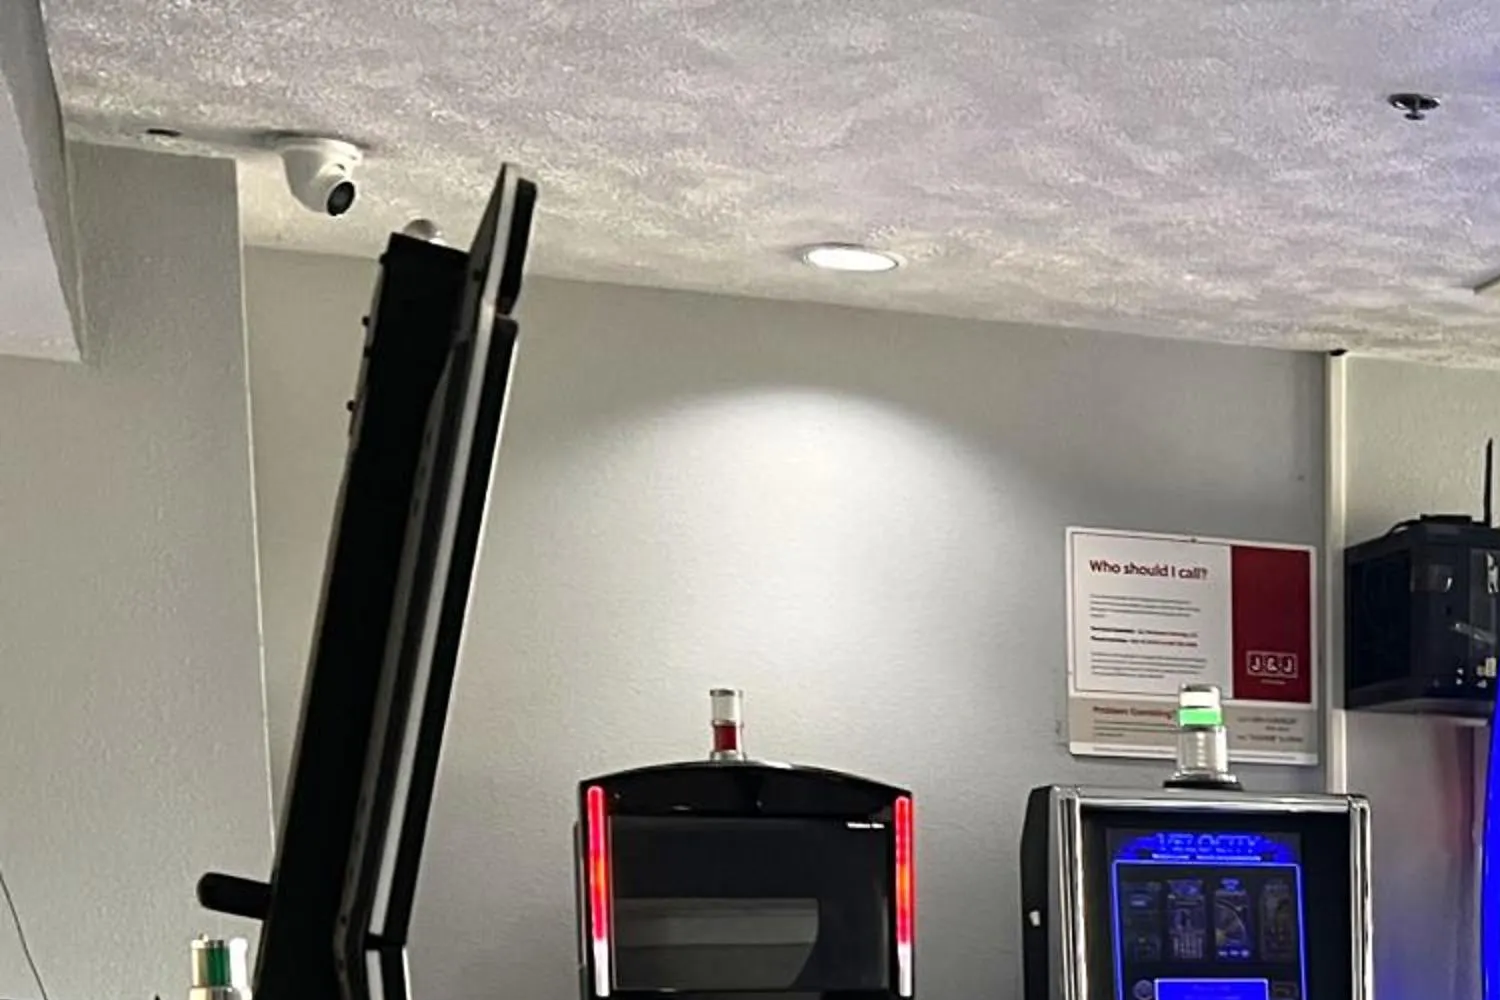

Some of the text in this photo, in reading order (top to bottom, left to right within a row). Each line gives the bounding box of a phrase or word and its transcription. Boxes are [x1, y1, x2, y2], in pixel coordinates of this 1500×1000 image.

[1089, 559, 1120, 573] Who
[1123, 561, 1168, 577] should
[1178, 566, 1208, 580] call?
